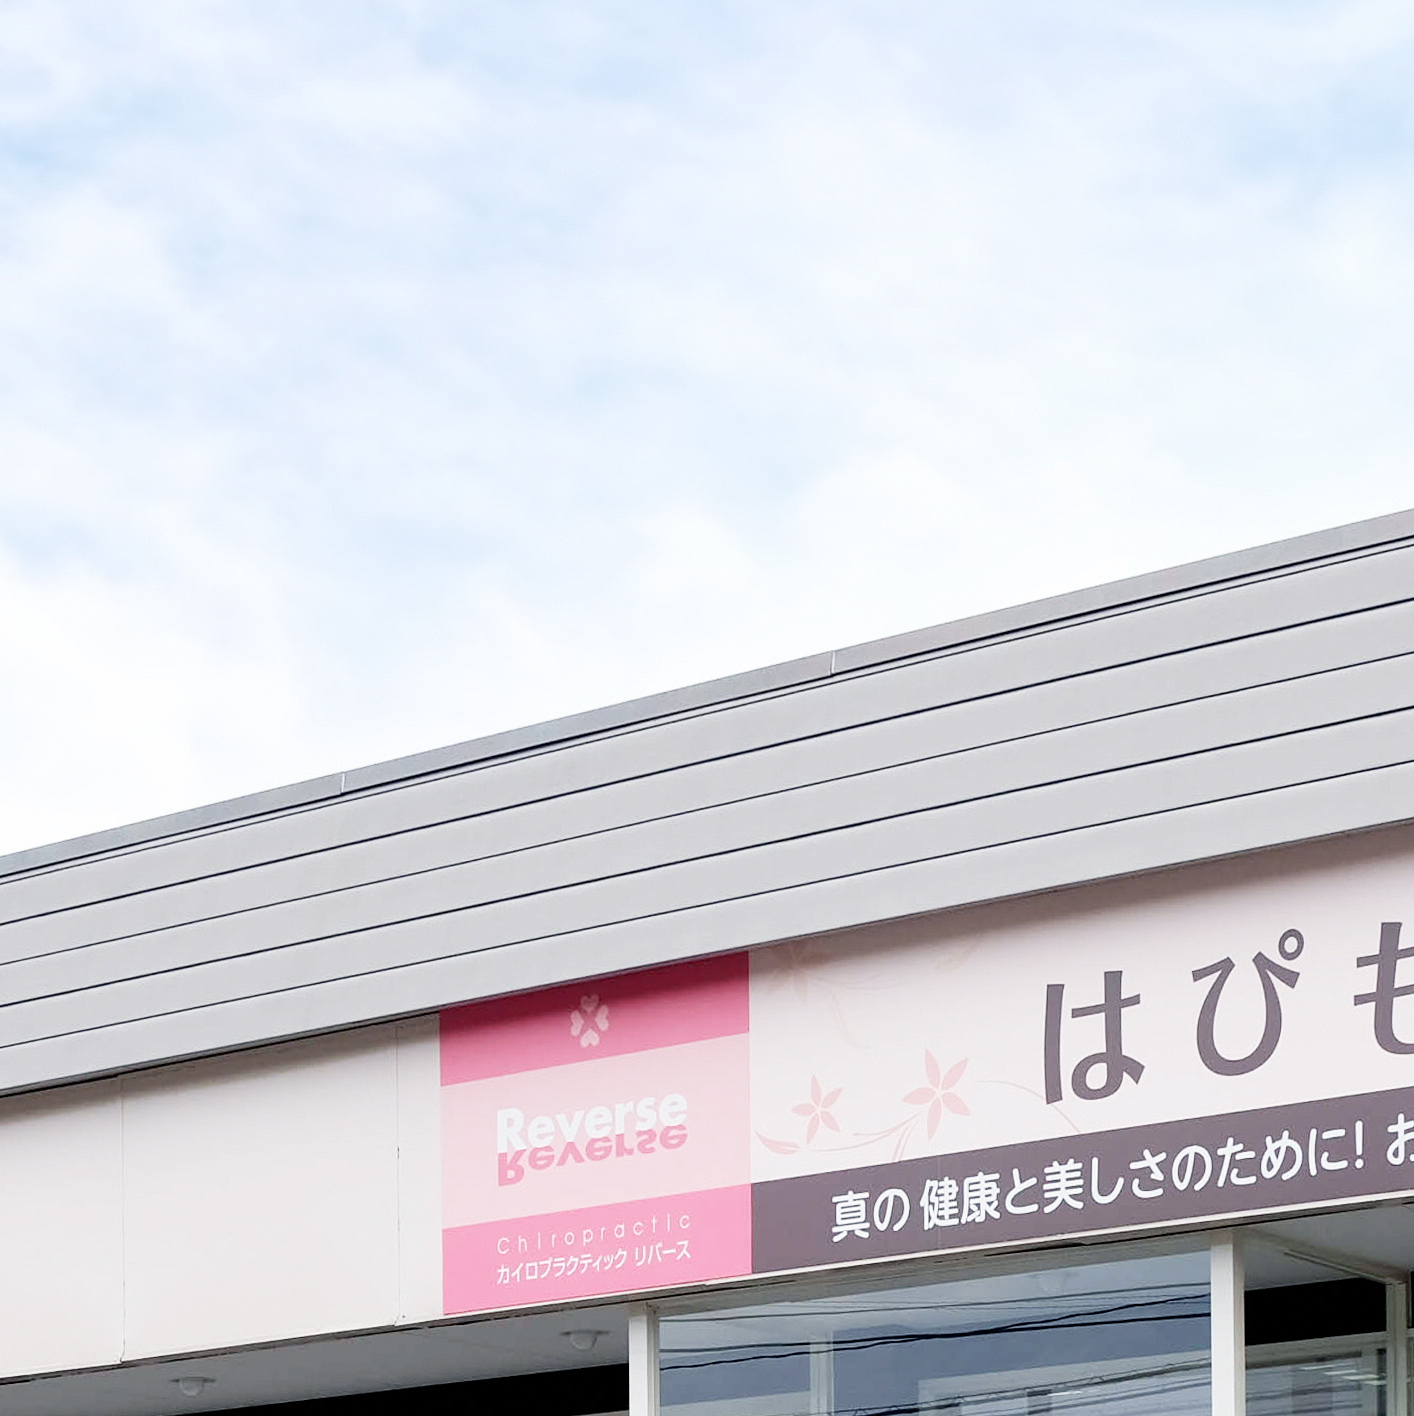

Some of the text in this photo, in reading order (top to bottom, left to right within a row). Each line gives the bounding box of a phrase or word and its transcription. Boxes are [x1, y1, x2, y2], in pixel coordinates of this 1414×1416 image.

[497, 1092, 688, 1151] Reverse
[497, 1213, 691, 1255] Chiropractic
[497, 1240, 691, 1285] カイロプラクティック リバース
